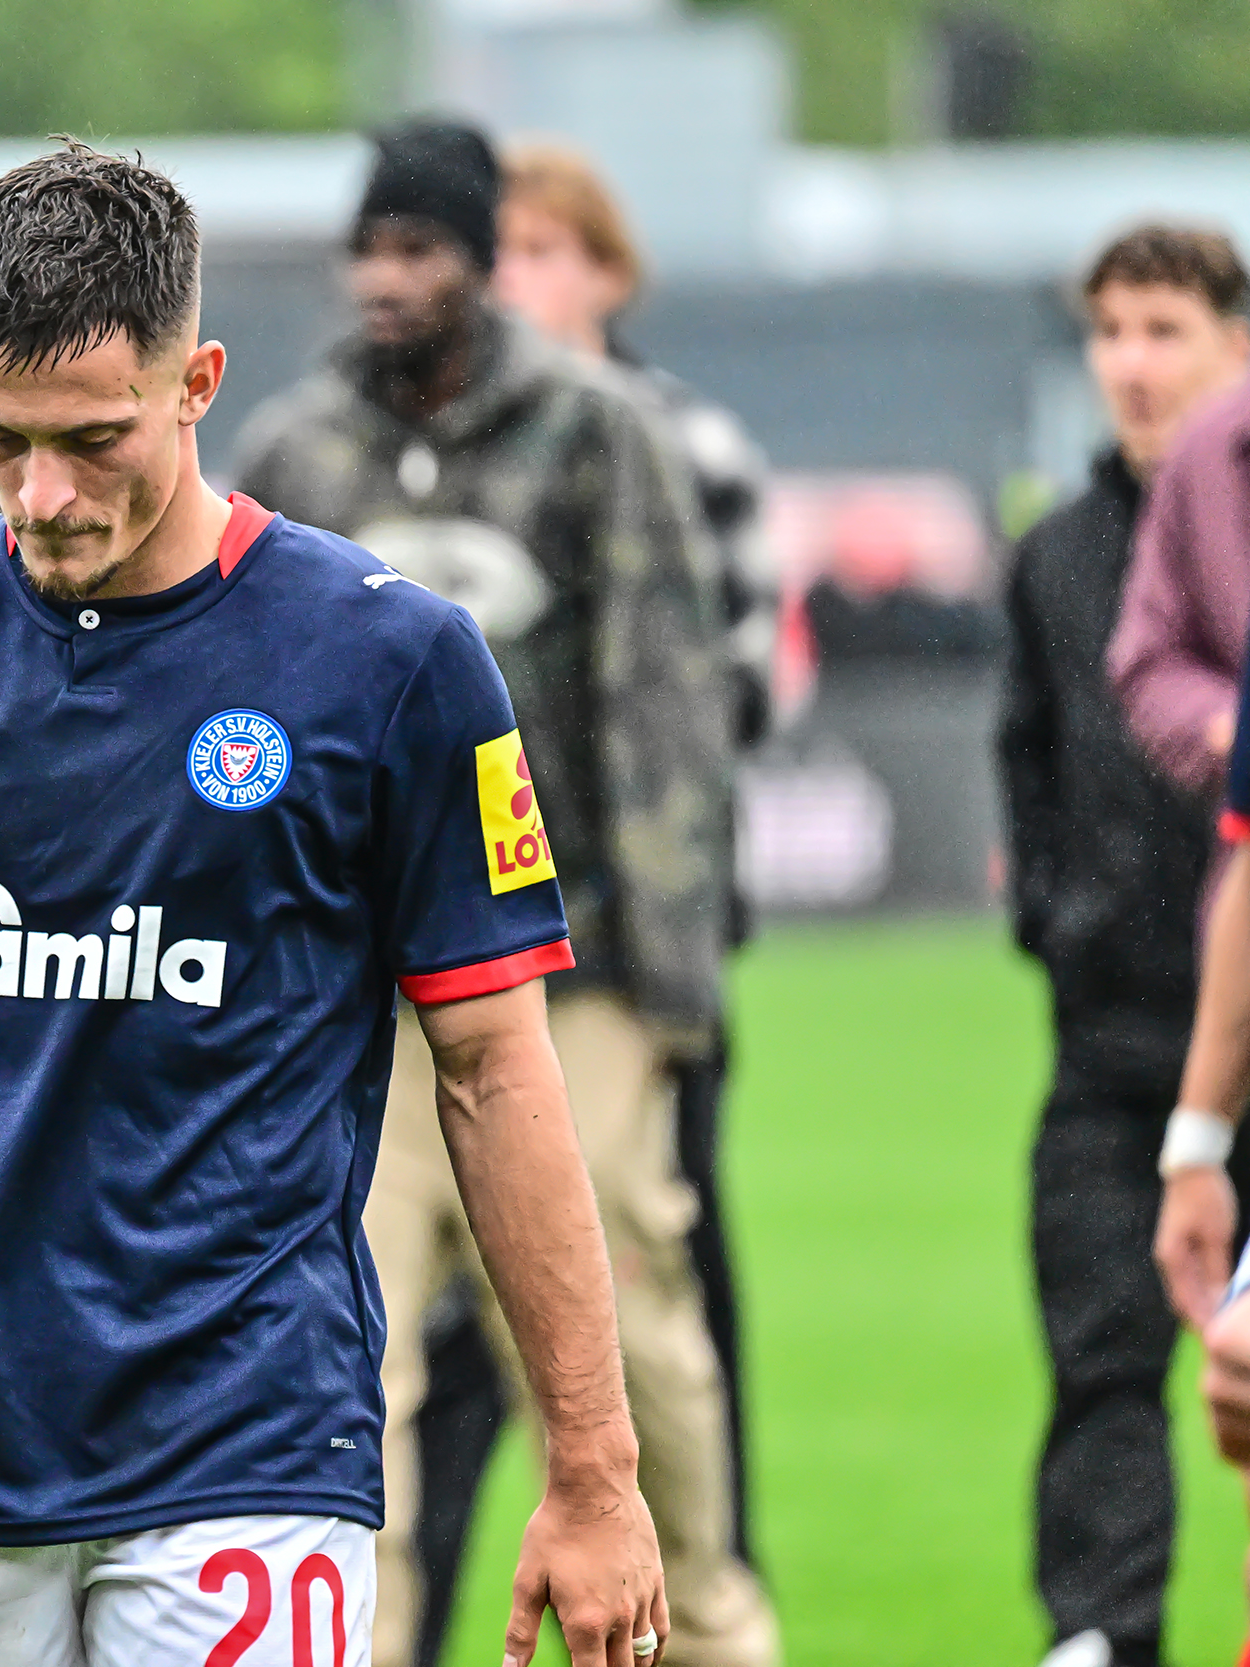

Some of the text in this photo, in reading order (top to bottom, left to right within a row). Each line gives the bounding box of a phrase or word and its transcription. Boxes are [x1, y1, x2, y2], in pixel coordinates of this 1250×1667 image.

[195, 723, 227, 772] KIELER
[246, 719, 282, 780] HOLSTEIN
[201, 774, 266, 803] VON 1900
[198, 1547, 346, 1667] 20
